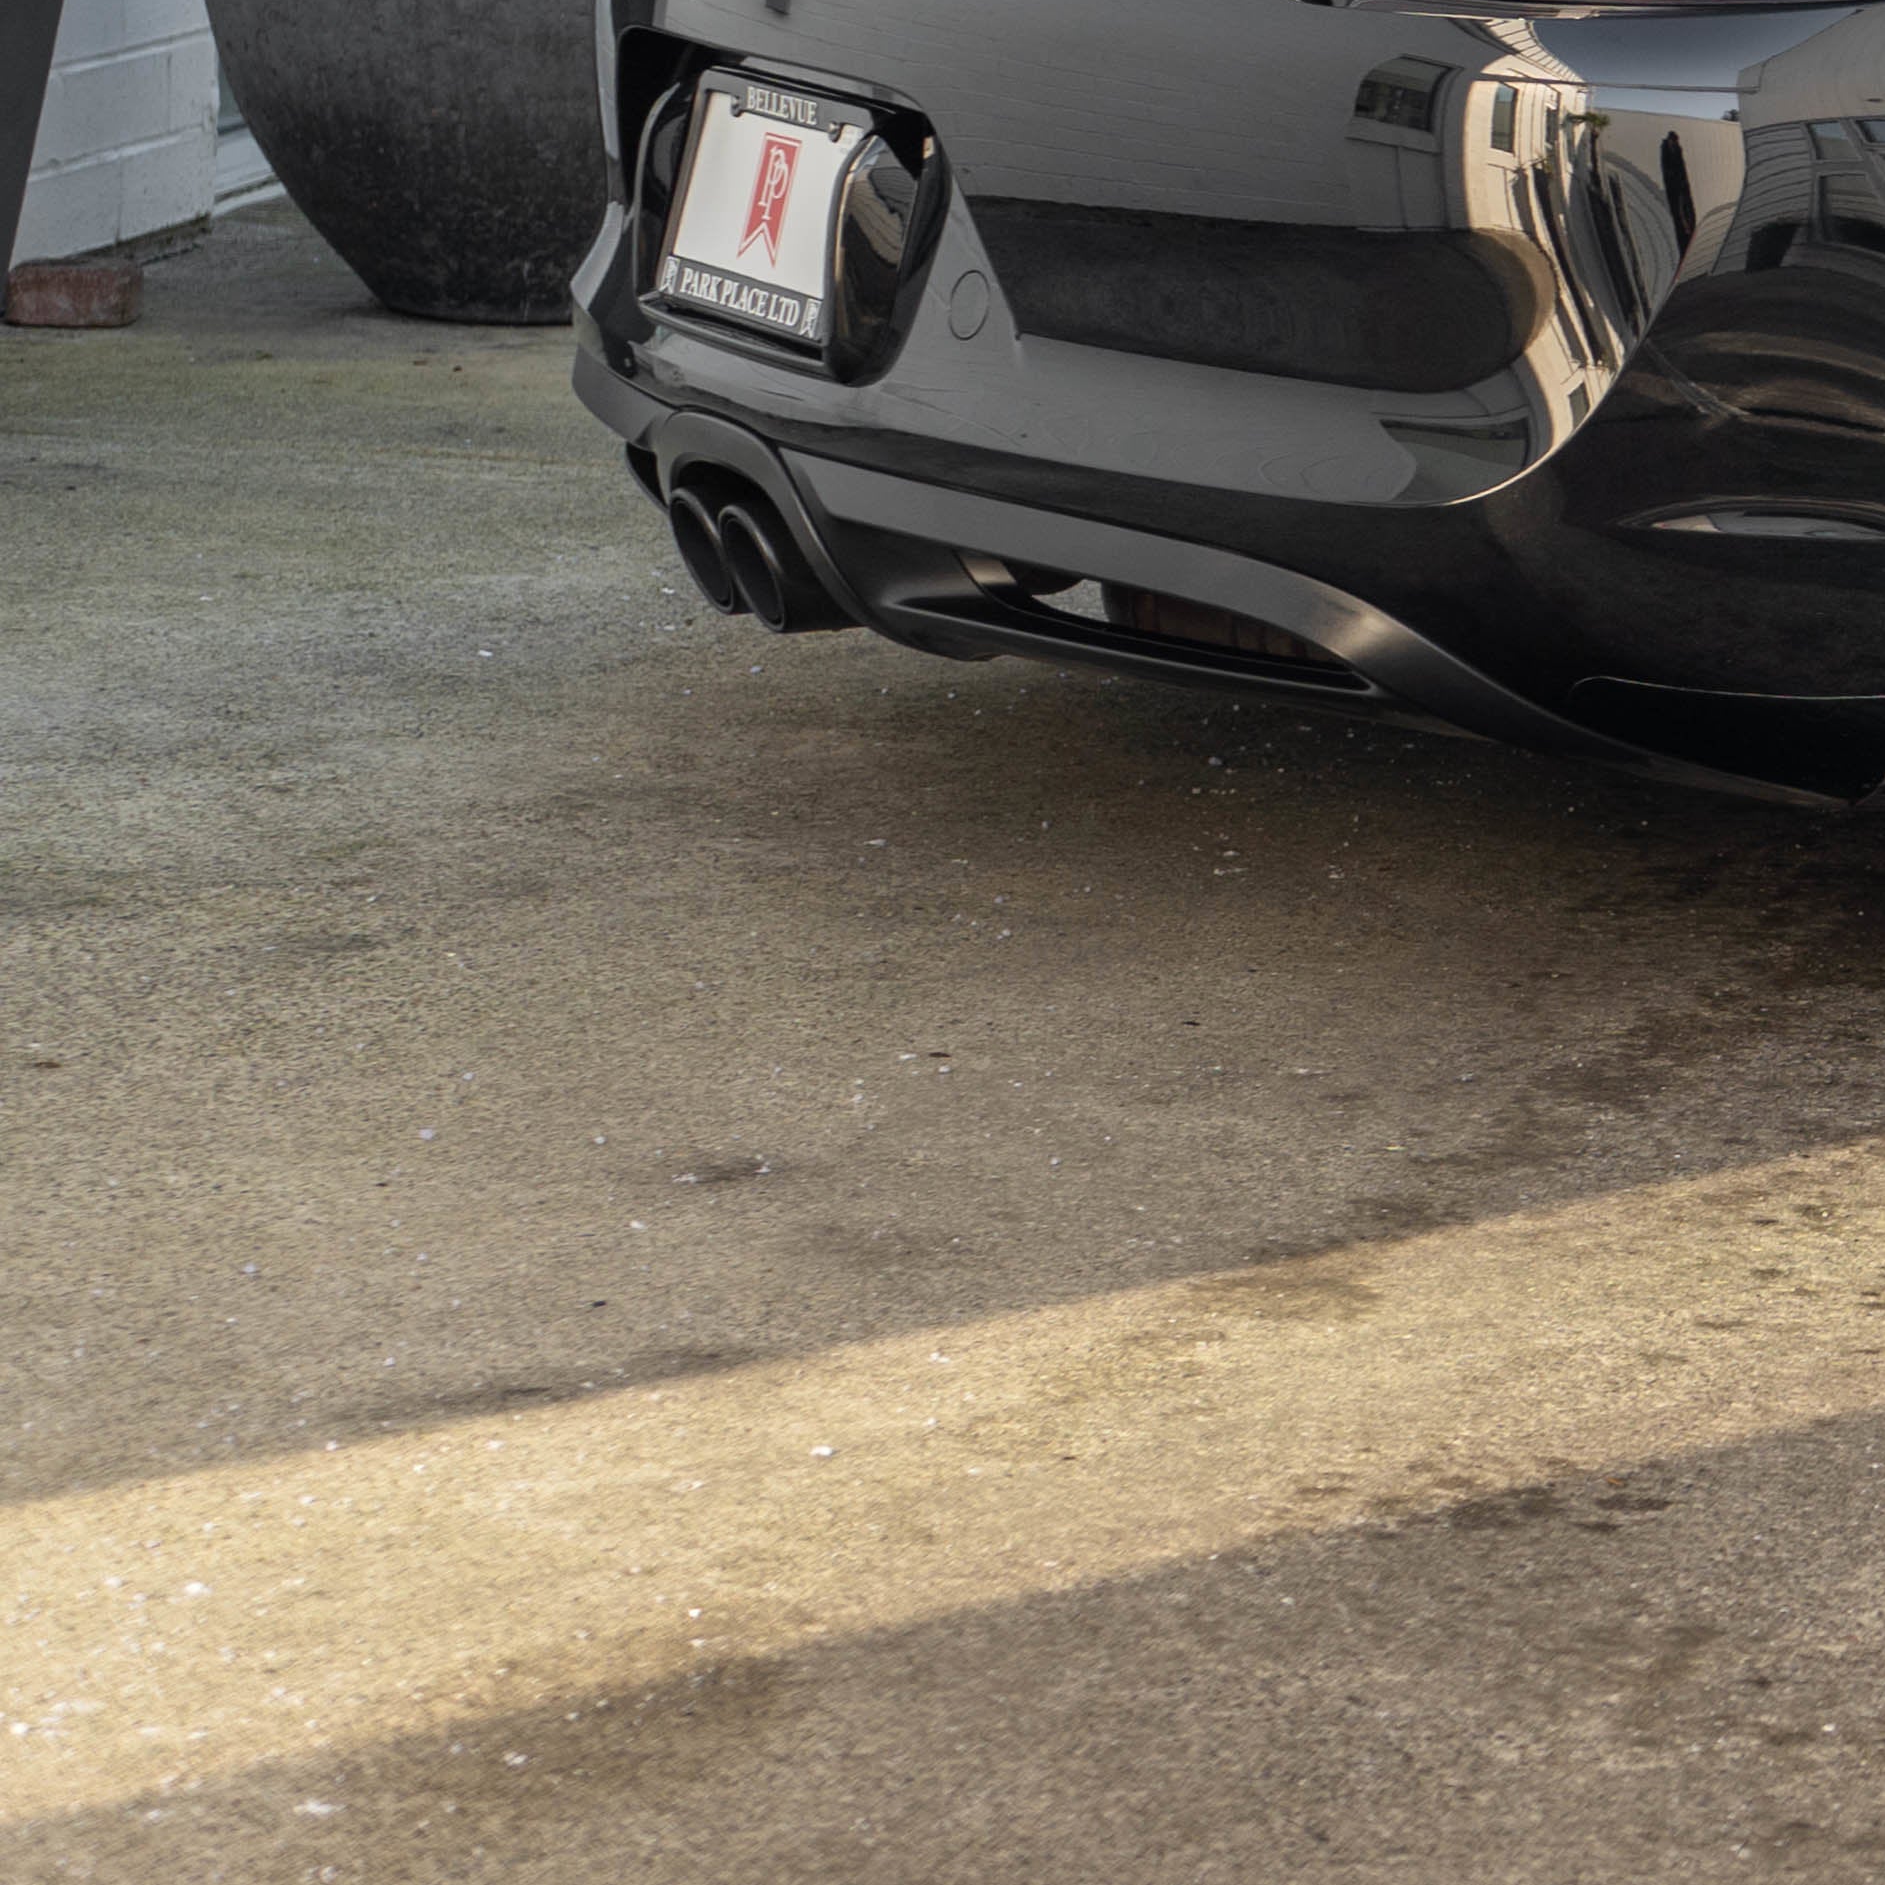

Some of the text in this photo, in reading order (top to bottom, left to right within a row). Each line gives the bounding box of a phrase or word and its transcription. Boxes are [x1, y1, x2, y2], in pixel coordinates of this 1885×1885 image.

[747, 86, 817, 125] BELLEVUE
[681, 267, 721, 302] PARK
[721, 280, 768, 316] PLACE
[768, 295, 800, 327] LTD
